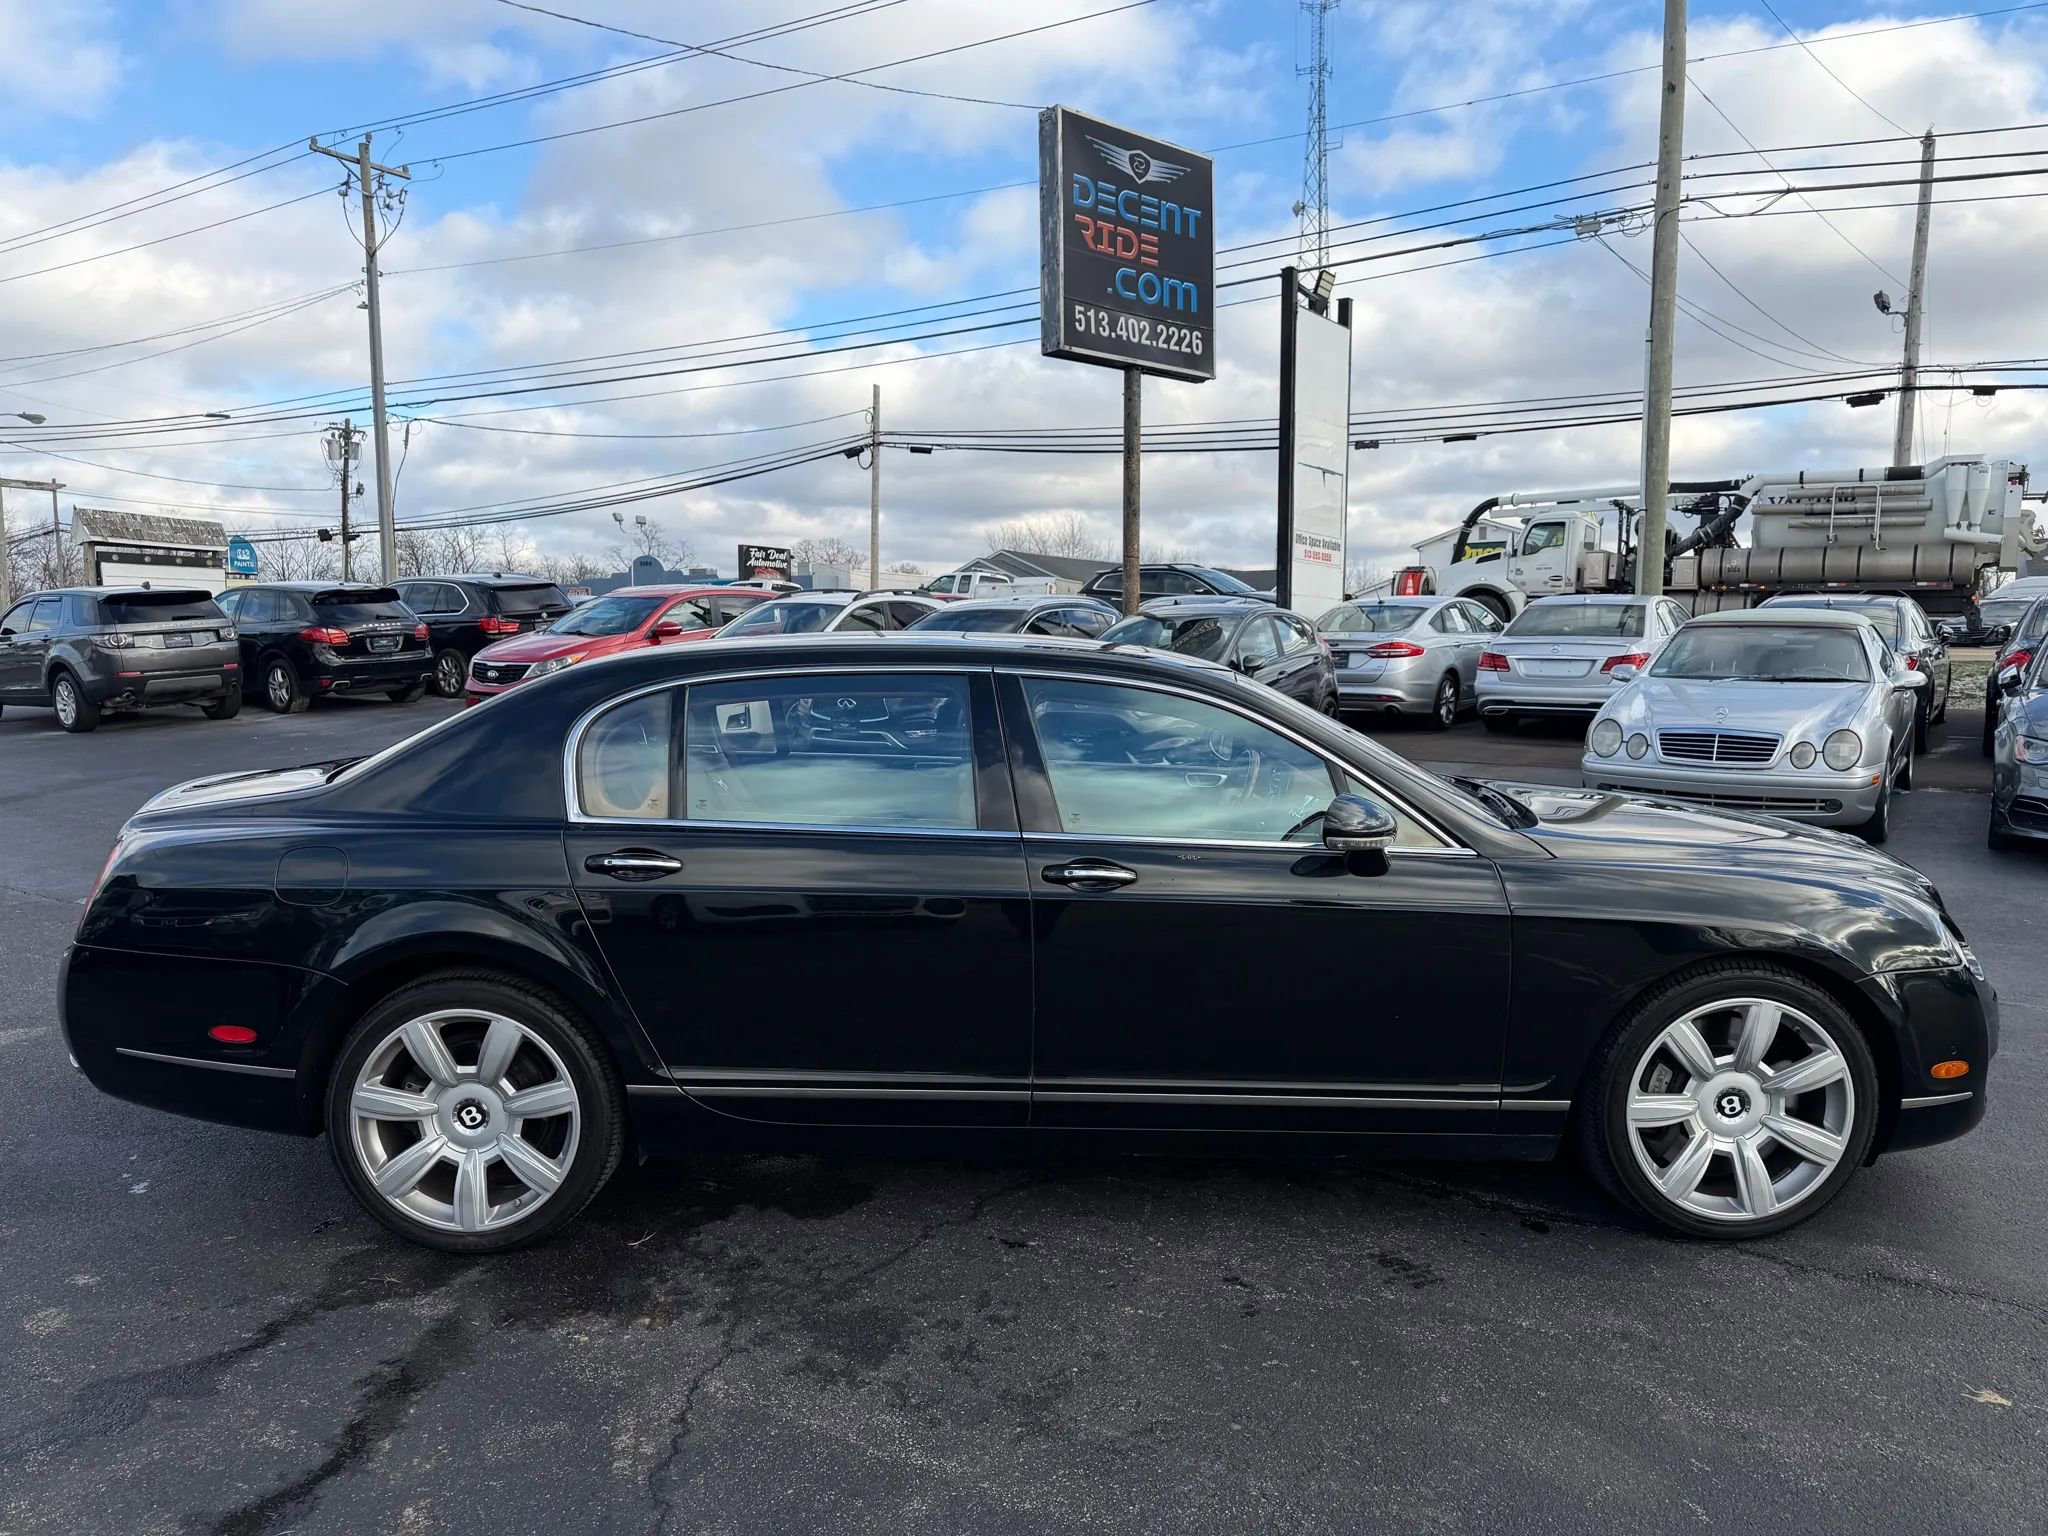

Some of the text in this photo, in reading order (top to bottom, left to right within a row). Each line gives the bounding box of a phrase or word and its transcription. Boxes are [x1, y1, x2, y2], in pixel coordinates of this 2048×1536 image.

[1074, 214, 1159, 267] RIDE
[1074, 304, 1203, 356] 513.402.2226
[749, 548, 787, 560] Fair Deal
[1308, 536, 1321, 548] Space
[1322, 538, 1341, 552] Available
[746, 557, 788, 569] Automotive
[1721, 1095, 1742, 1115] B
[460, 1106, 482, 1126] B
